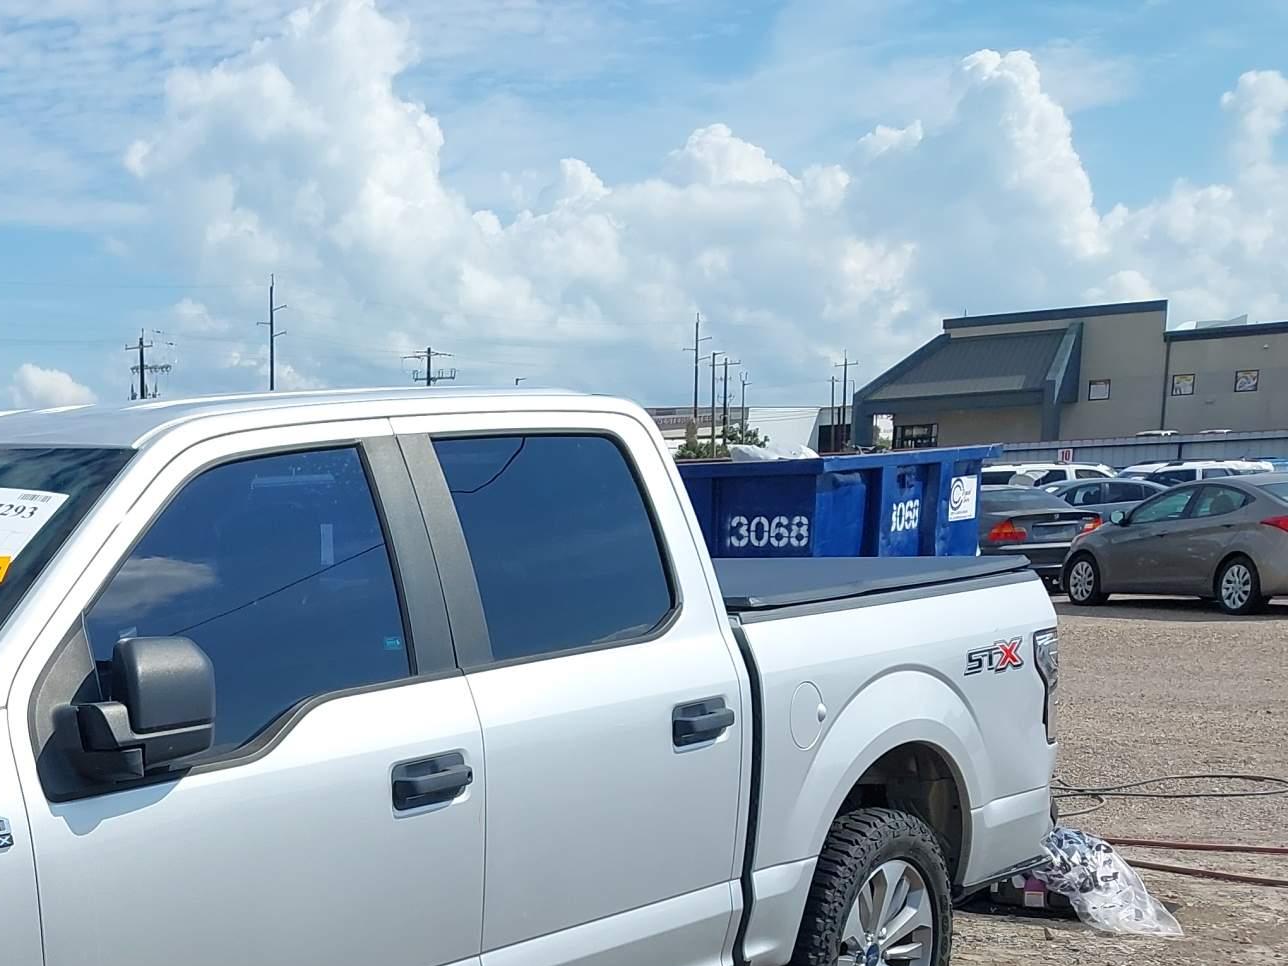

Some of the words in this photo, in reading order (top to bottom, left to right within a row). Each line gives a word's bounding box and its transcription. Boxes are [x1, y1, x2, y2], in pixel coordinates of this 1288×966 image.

[1062, 450, 1071, 461] 10
[730, 515, 809, 547] 3068
[964, 636, 1024, 676] STX
